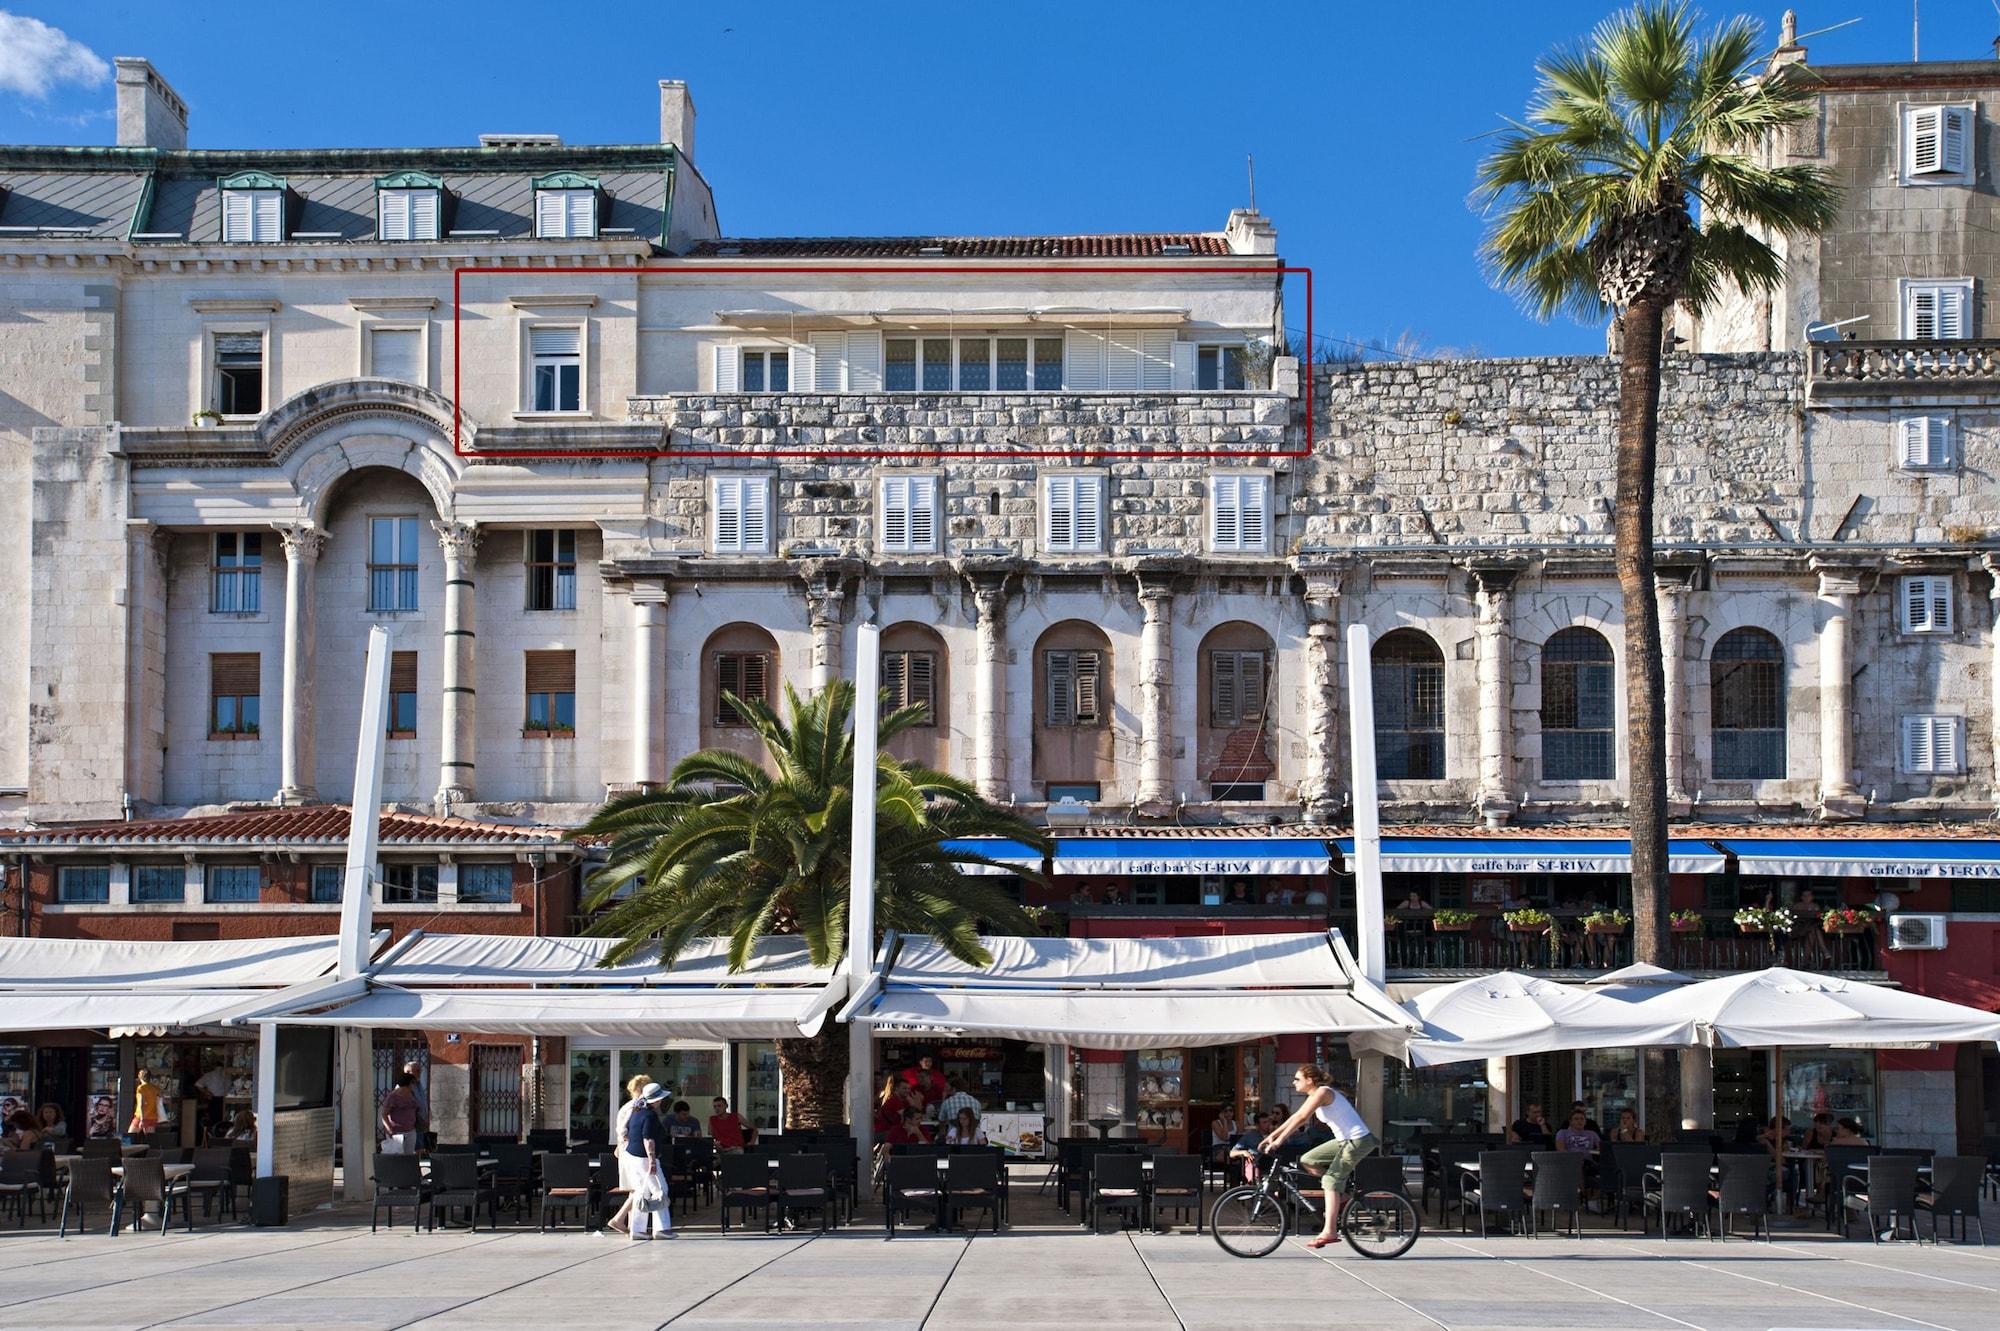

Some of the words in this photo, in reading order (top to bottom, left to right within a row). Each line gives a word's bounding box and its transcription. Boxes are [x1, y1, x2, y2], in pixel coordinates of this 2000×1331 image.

[1129, 863, 1160, 873] caffe
[1164, 863, 1186, 873] bar
[1193, 863, 1251, 873] ST-RIVA
[1471, 860, 1503, 871] caffe
[1507, 860, 1529, 871] bar
[1536, 861, 1596, 871] ST-RIVA
[1870, 865, 1903, 876] caffe
[1907, 866, 1930, 876] bar
[1938, 866, 2000, 877] ST-RIVA
